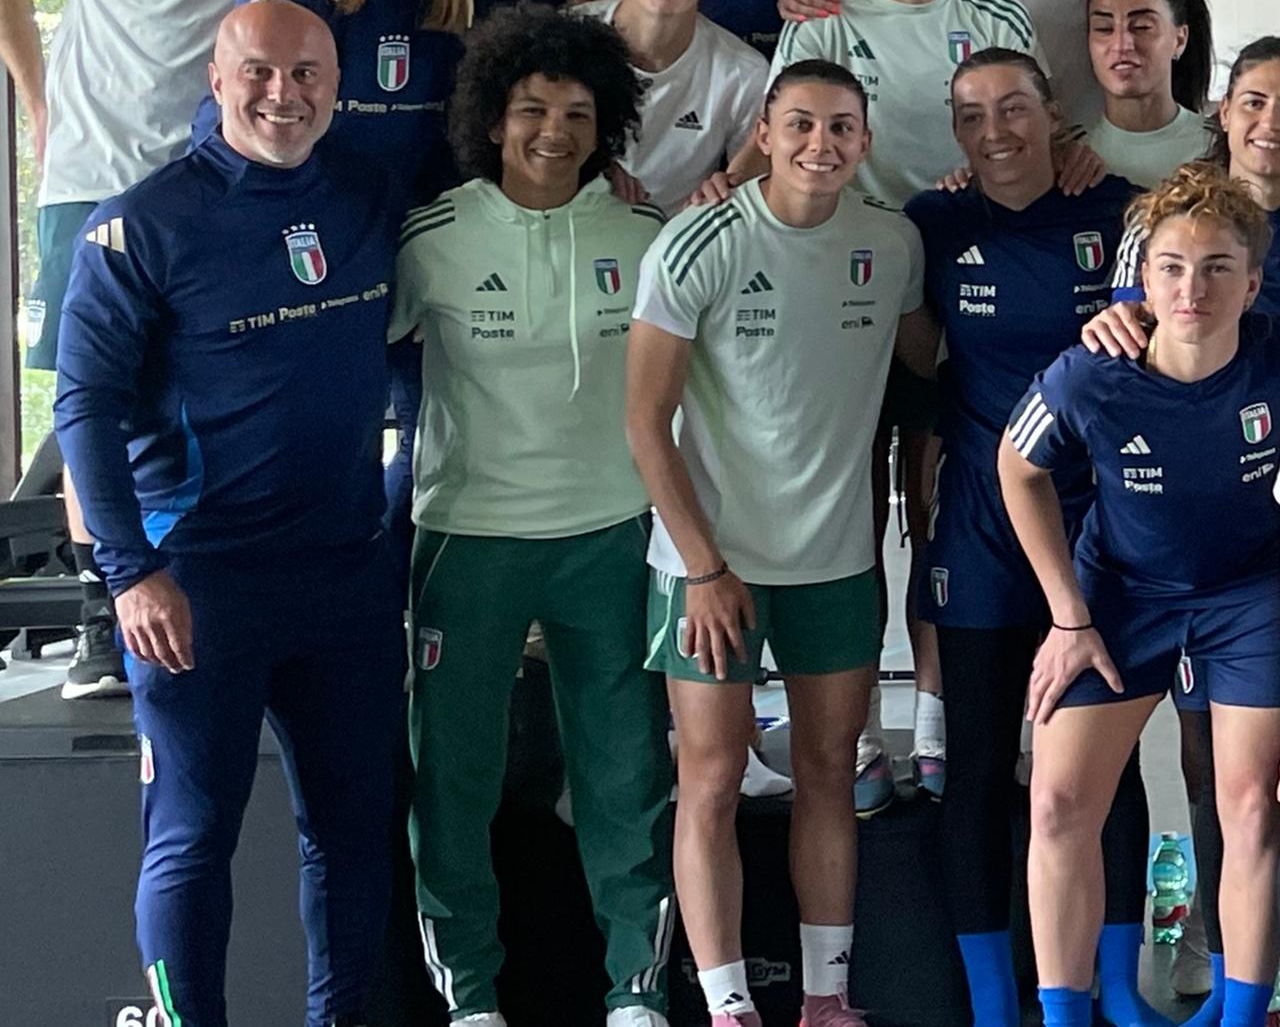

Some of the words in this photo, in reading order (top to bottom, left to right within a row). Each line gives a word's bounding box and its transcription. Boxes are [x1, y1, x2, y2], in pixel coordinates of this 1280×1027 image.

[971, 286, 997, 298] TIM
[959, 299, 996, 314] Poste
[247, 311, 276, 330] TIM
[279, 300, 316, 321] Poste
[488, 310, 515, 322] TIM
[751, 309, 777, 320] TIM
[471, 326, 515, 339] Poste
[736, 326, 775, 338] Poste
[1136, 467, 1163, 479] TIM
